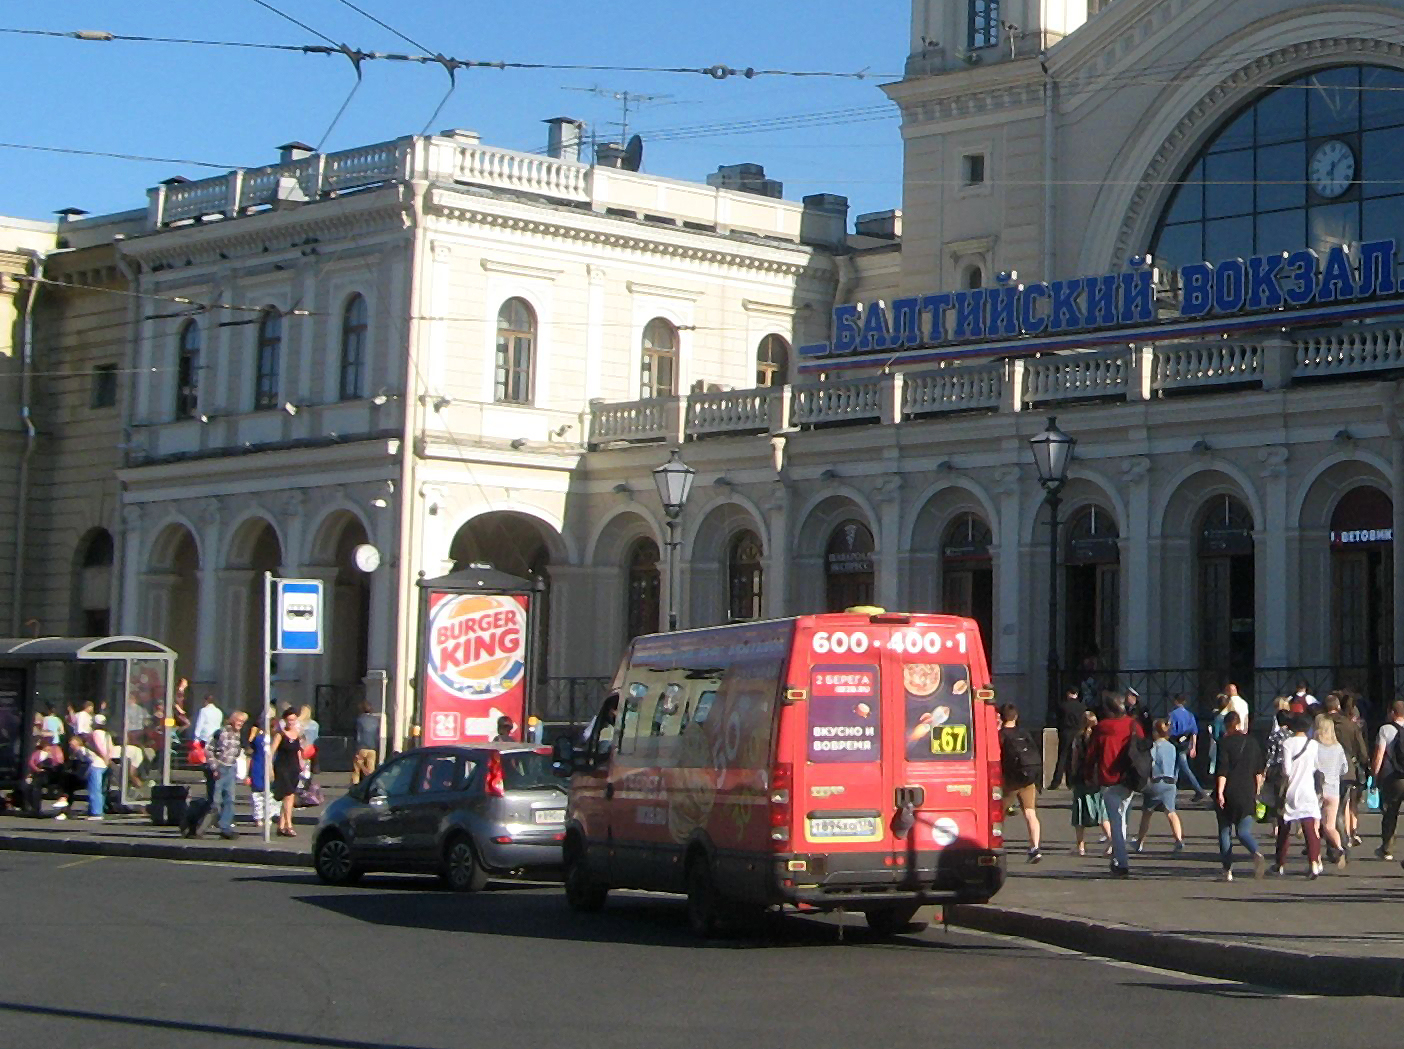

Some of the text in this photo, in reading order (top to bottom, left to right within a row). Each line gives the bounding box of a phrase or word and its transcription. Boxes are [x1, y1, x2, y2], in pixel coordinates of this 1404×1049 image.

[831, 239, 1396, 352] БАЛТИЙСКИЙ ВОКЗАЛ
[437, 609, 518, 646] BURGER
[439, 628, 520, 673] KING
[812, 726, 863, 737] ВКУСНО
[812, 740, 872, 751] ВОВРЕМЯ
